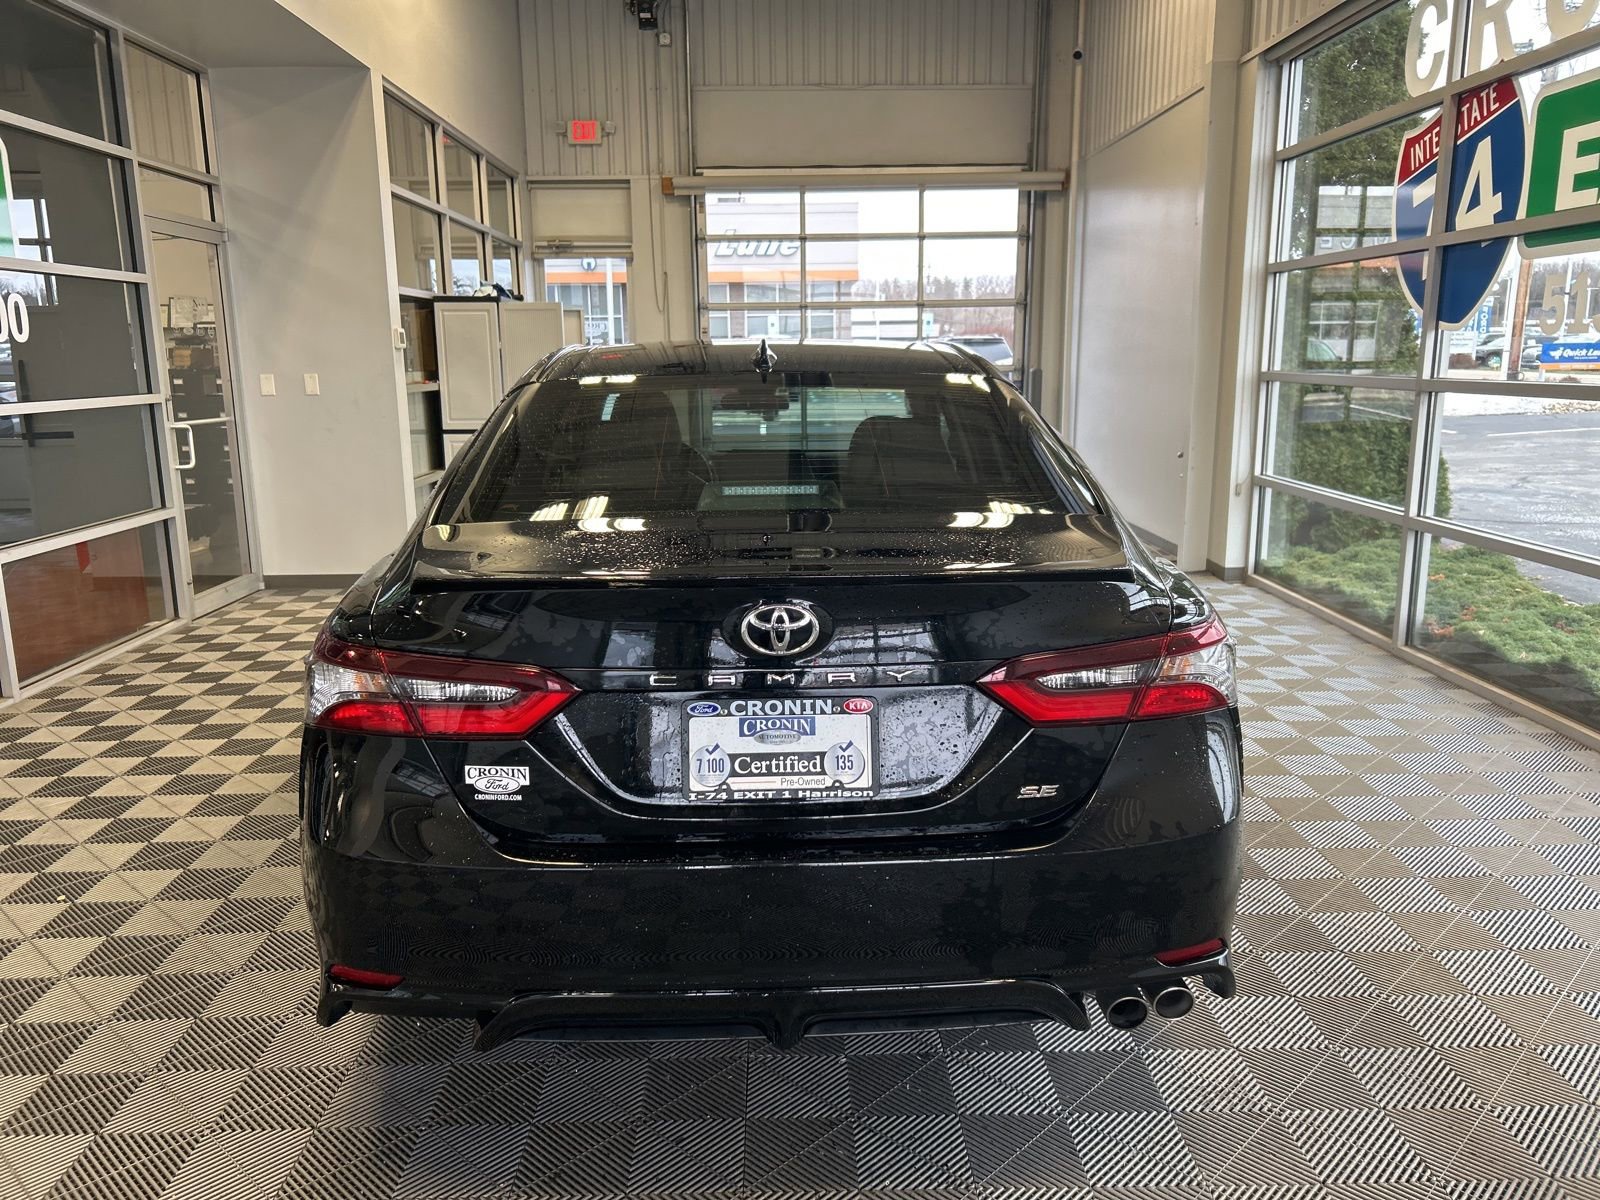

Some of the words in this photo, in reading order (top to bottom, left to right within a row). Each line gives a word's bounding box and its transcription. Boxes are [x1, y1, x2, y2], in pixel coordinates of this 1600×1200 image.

[1410, 82, 1500, 172] INTETATE
[1538, 271, 1600, 336] 51
[649, 669, 916, 687] CAMRY
[729, 700, 832, 716] CRONIN
[743, 718, 812, 735] CRONIN
[734, 755, 822, 774] Certified
[835, 754, 854, 771] 135
[467, 767, 527, 781] CRONIN
[780, 777, 826, 787] Pre-Owned
[484, 778, 510, 791] Ford
[1017, 784, 1060, 799] SE
[474, 793, 523, 801] CRONINFORD.COM
[689, 791, 728, 801] I-74
[733, 791, 776, 799] EXIT
[781, 790, 792, 798] 1
[798, 789, 874, 798] Harrison
